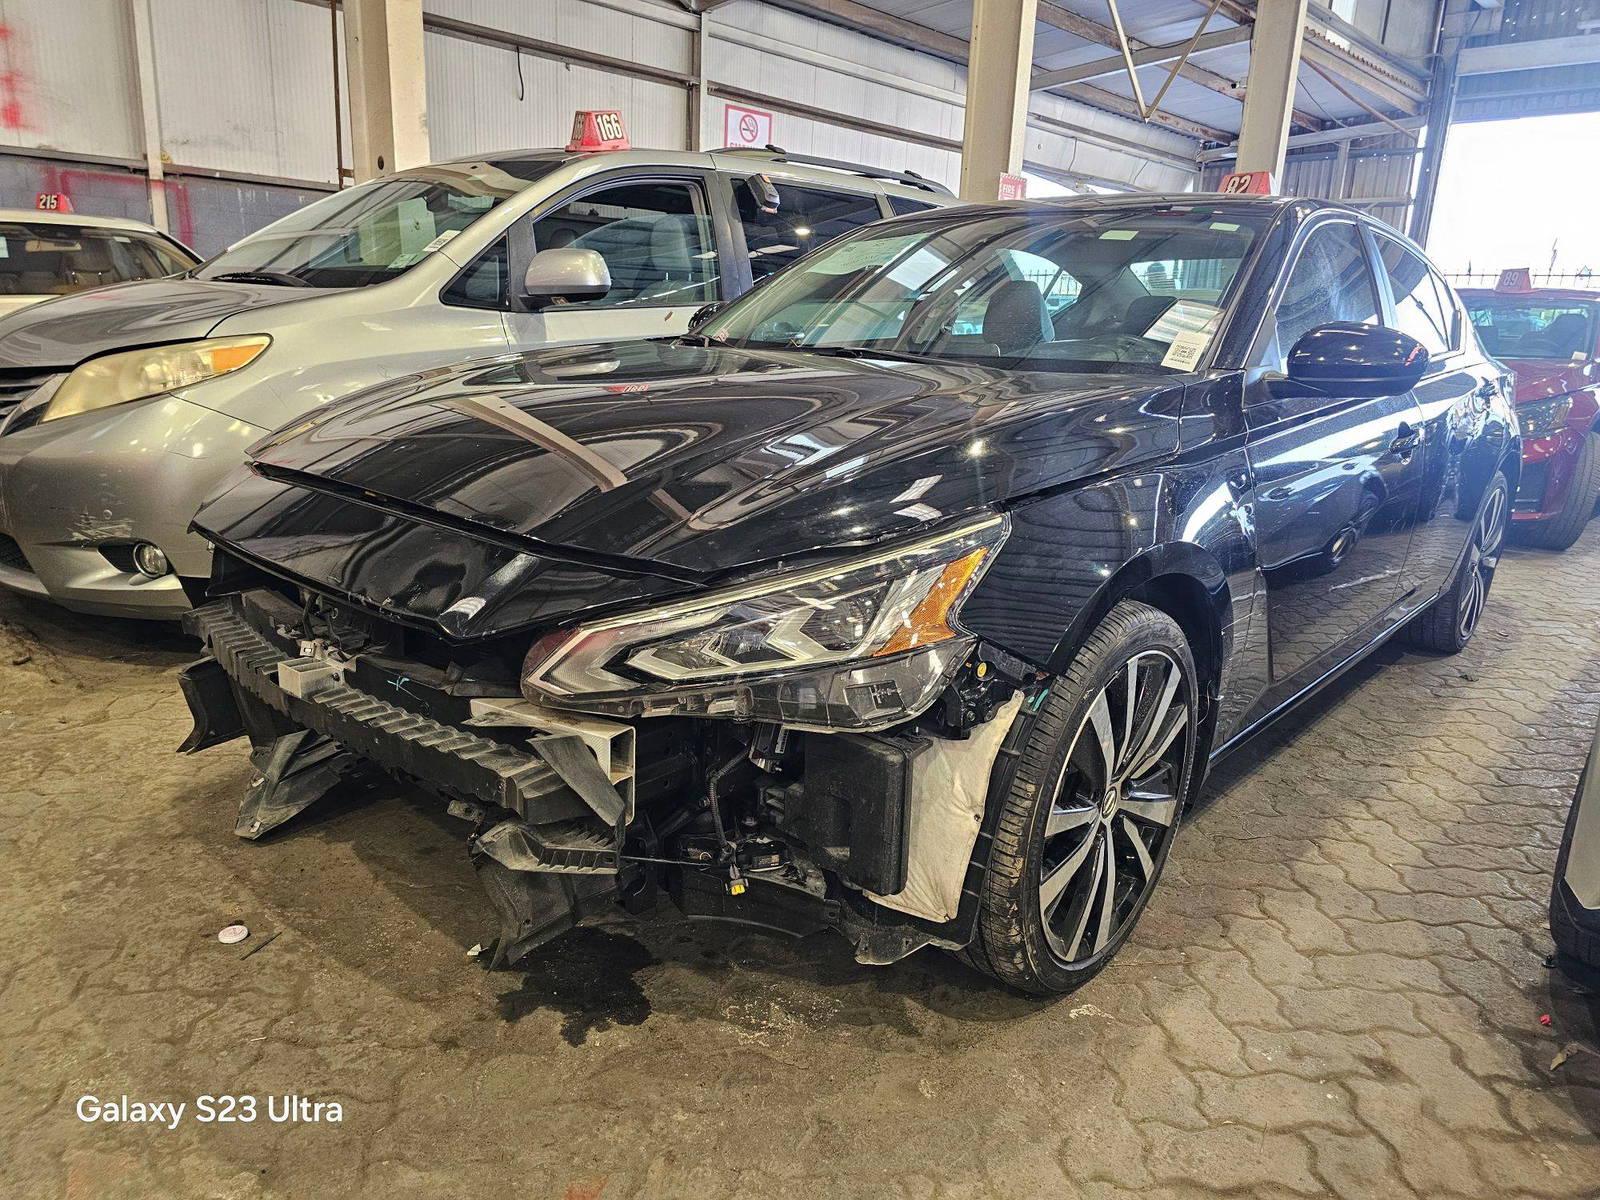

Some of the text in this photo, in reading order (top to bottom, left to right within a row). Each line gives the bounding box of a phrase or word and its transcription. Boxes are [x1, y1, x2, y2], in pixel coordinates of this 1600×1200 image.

[596, 113, 623, 141] 166
[1225, 174, 1252, 194] 82
[40, 194, 58, 209] 215
